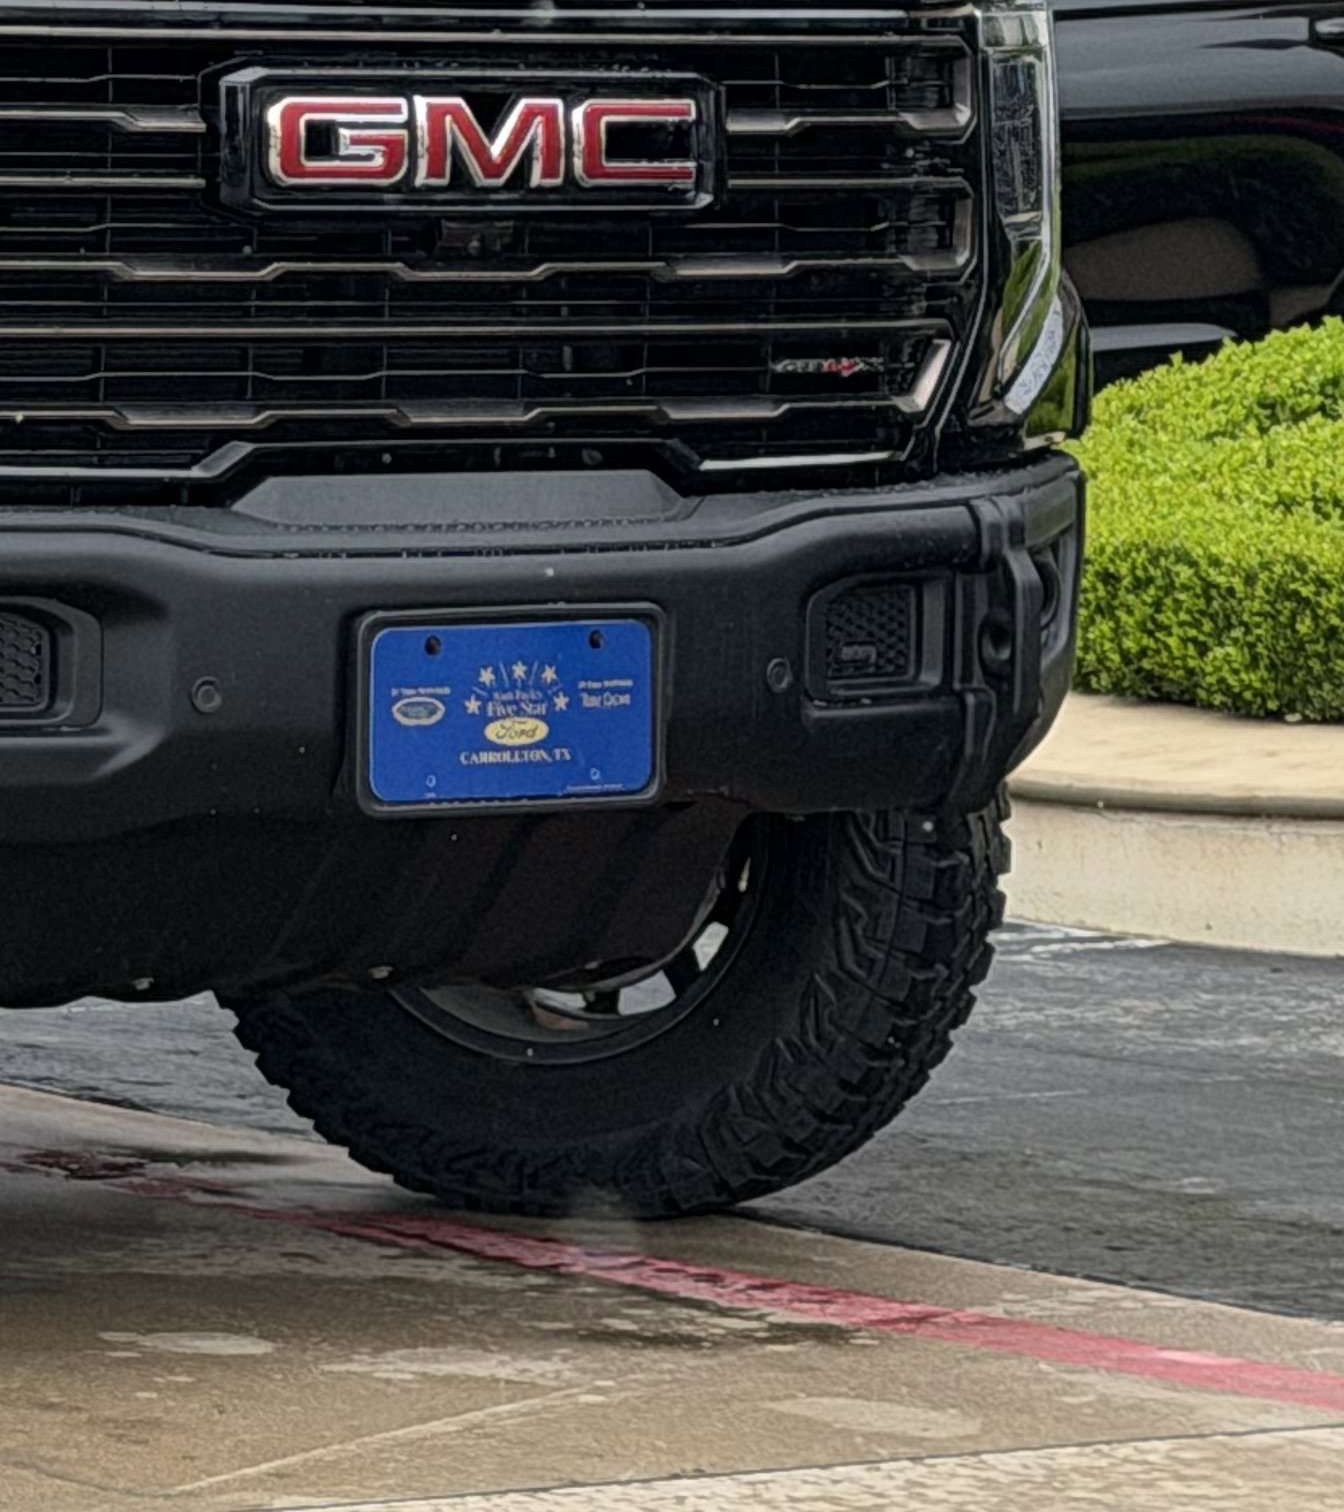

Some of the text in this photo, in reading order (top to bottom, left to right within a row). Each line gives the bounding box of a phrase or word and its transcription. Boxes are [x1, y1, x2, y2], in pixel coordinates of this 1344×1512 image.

[267, 95, 698, 188] GMC
[486, 699, 548, 717] Five Star
[495, 720, 540, 740] Ford
